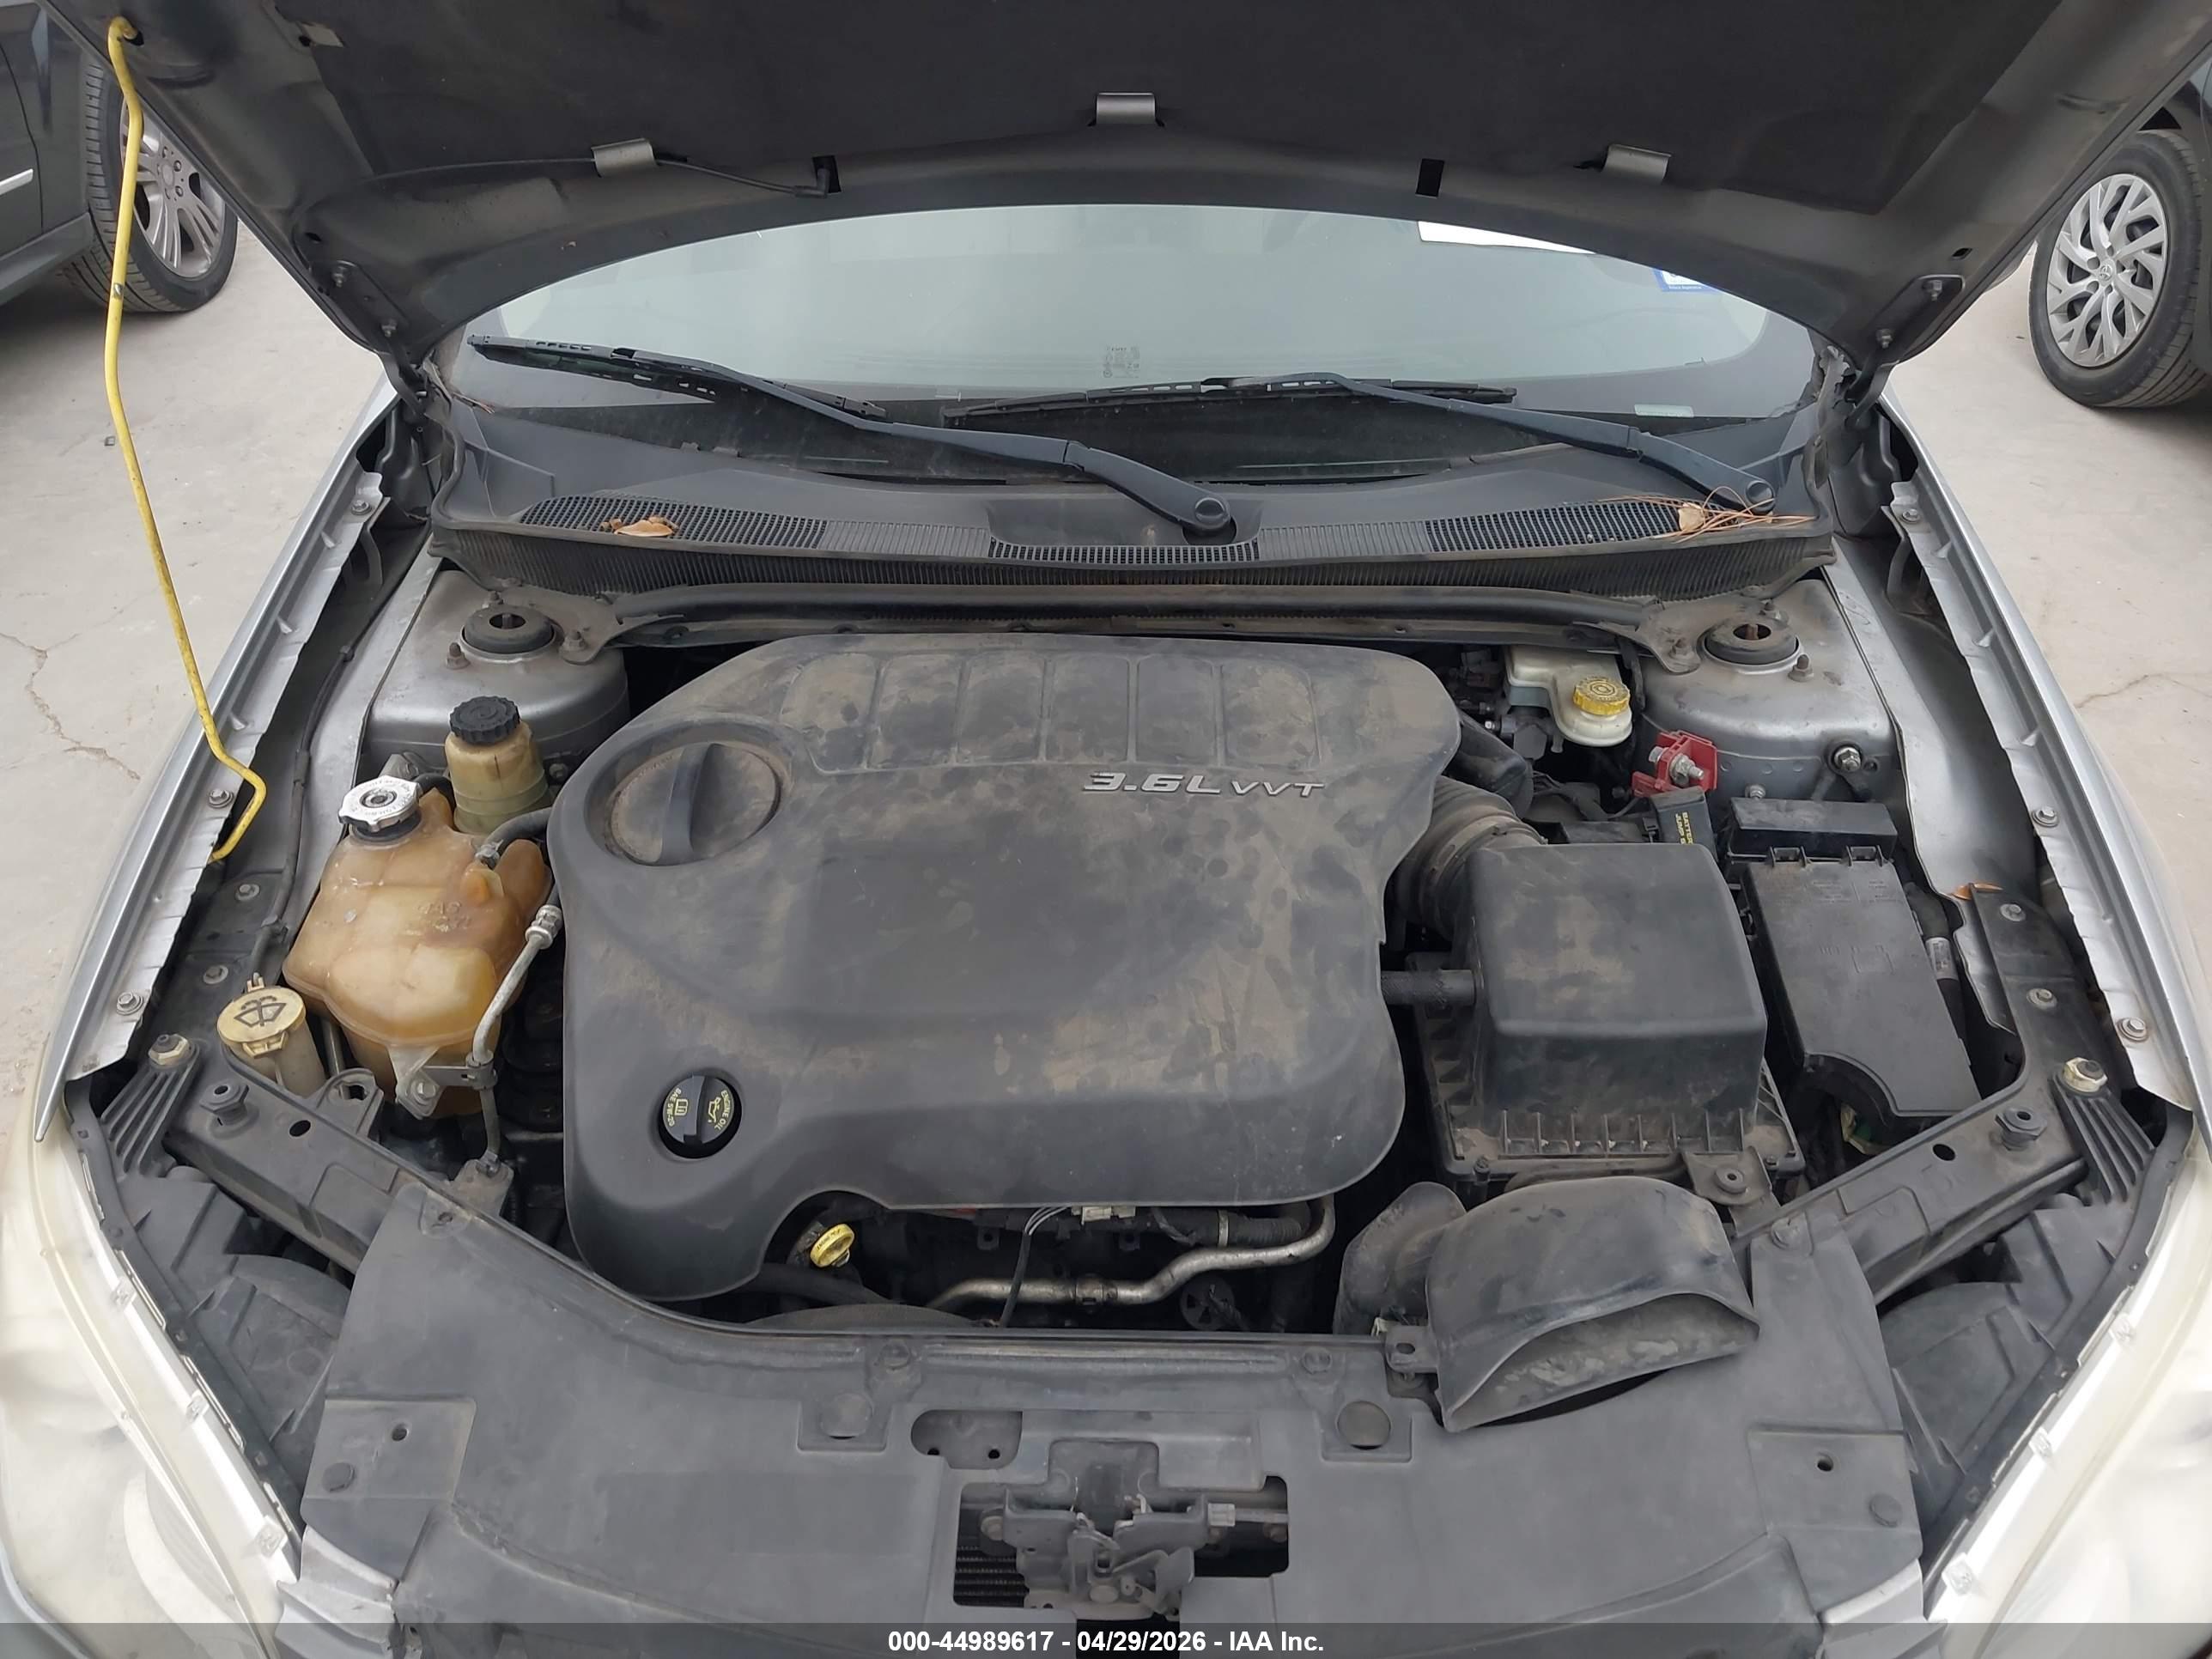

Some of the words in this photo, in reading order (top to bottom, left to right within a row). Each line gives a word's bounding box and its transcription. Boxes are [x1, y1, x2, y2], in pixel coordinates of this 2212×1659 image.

[1083, 772, 1221, 794] 3.6L
[1231, 780, 1326, 797] VVT
[1675, 813, 1685, 836] JUMP
[1682, 811, 1693, 845] BATTER
[720, 1090, 731, 1118] ENGINE
[714, 1118, 726, 1131] OIL
